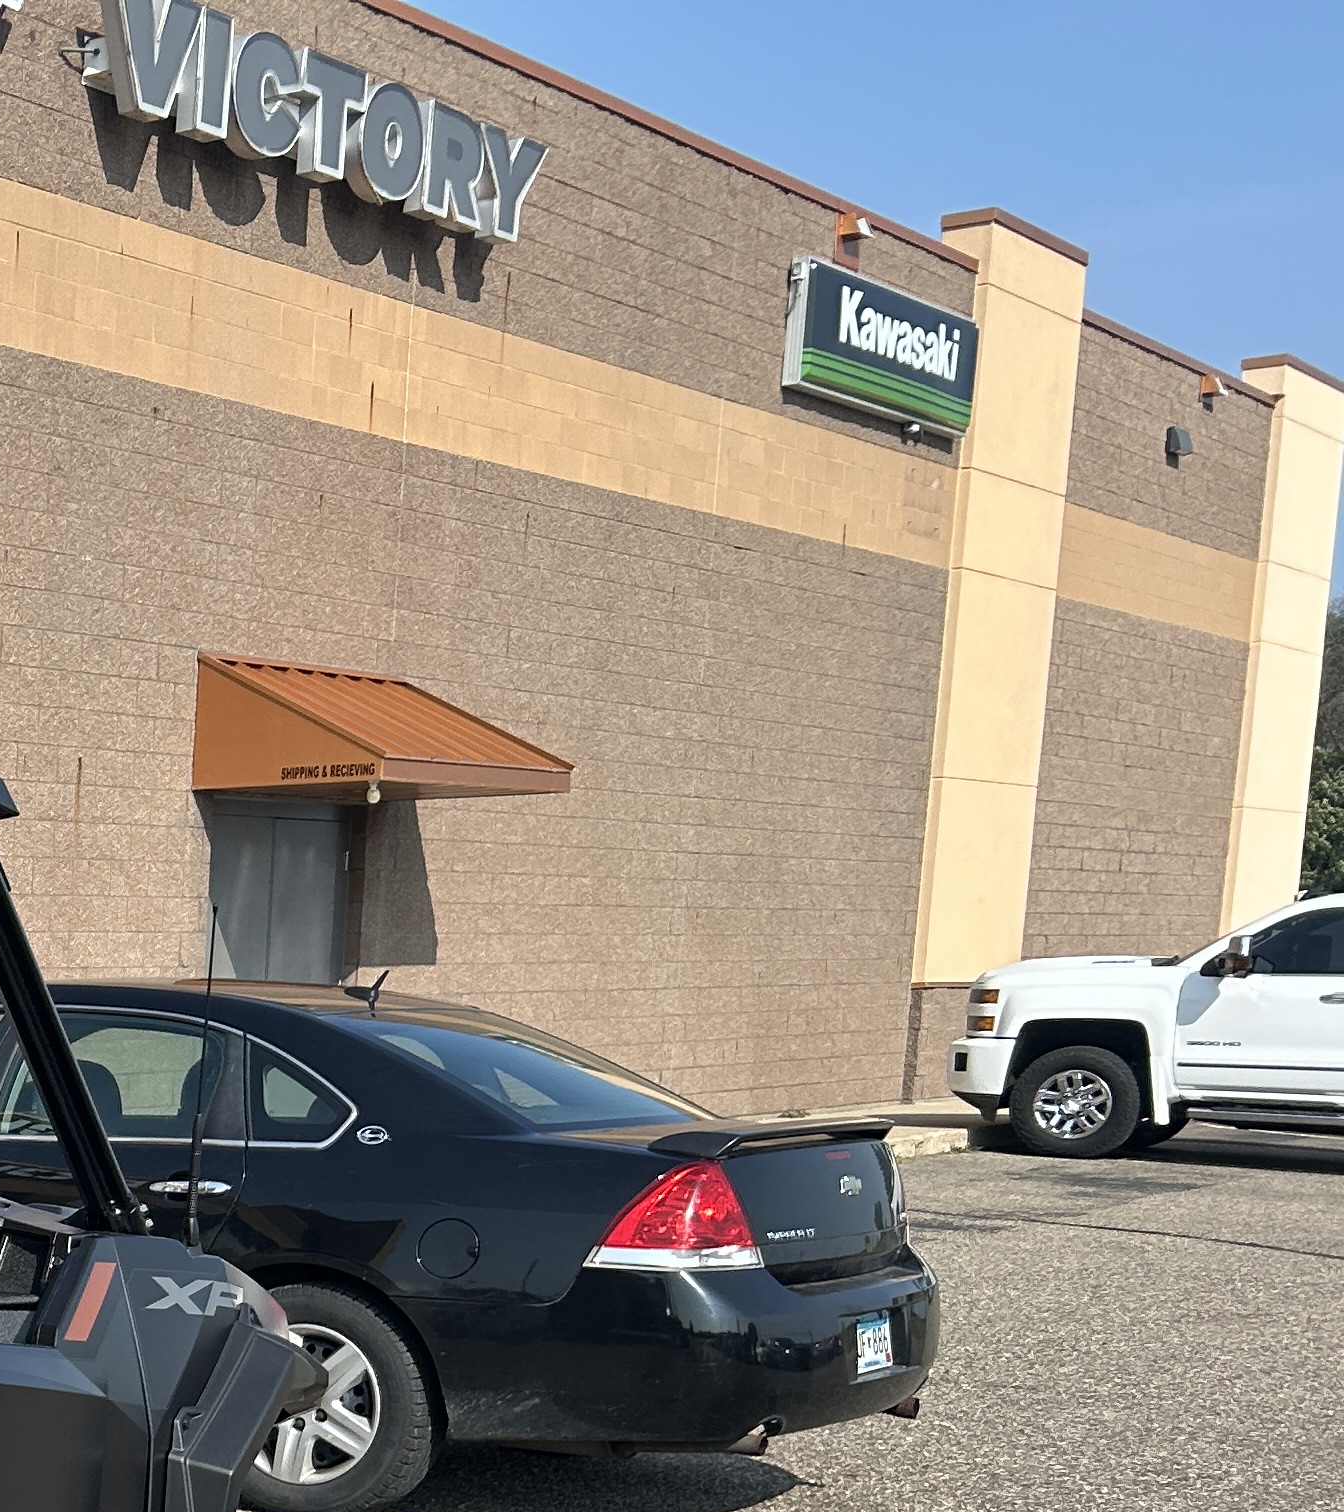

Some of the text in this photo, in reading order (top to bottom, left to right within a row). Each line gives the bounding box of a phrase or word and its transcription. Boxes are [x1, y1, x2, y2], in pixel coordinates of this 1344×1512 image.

[108, 0, 550, 242] VICTORY
[838, 284, 961, 382] Kawasaki
[281, 762, 375, 781] SHIPPING & RECIEVING
[144, 1276, 244, 1316] XP
